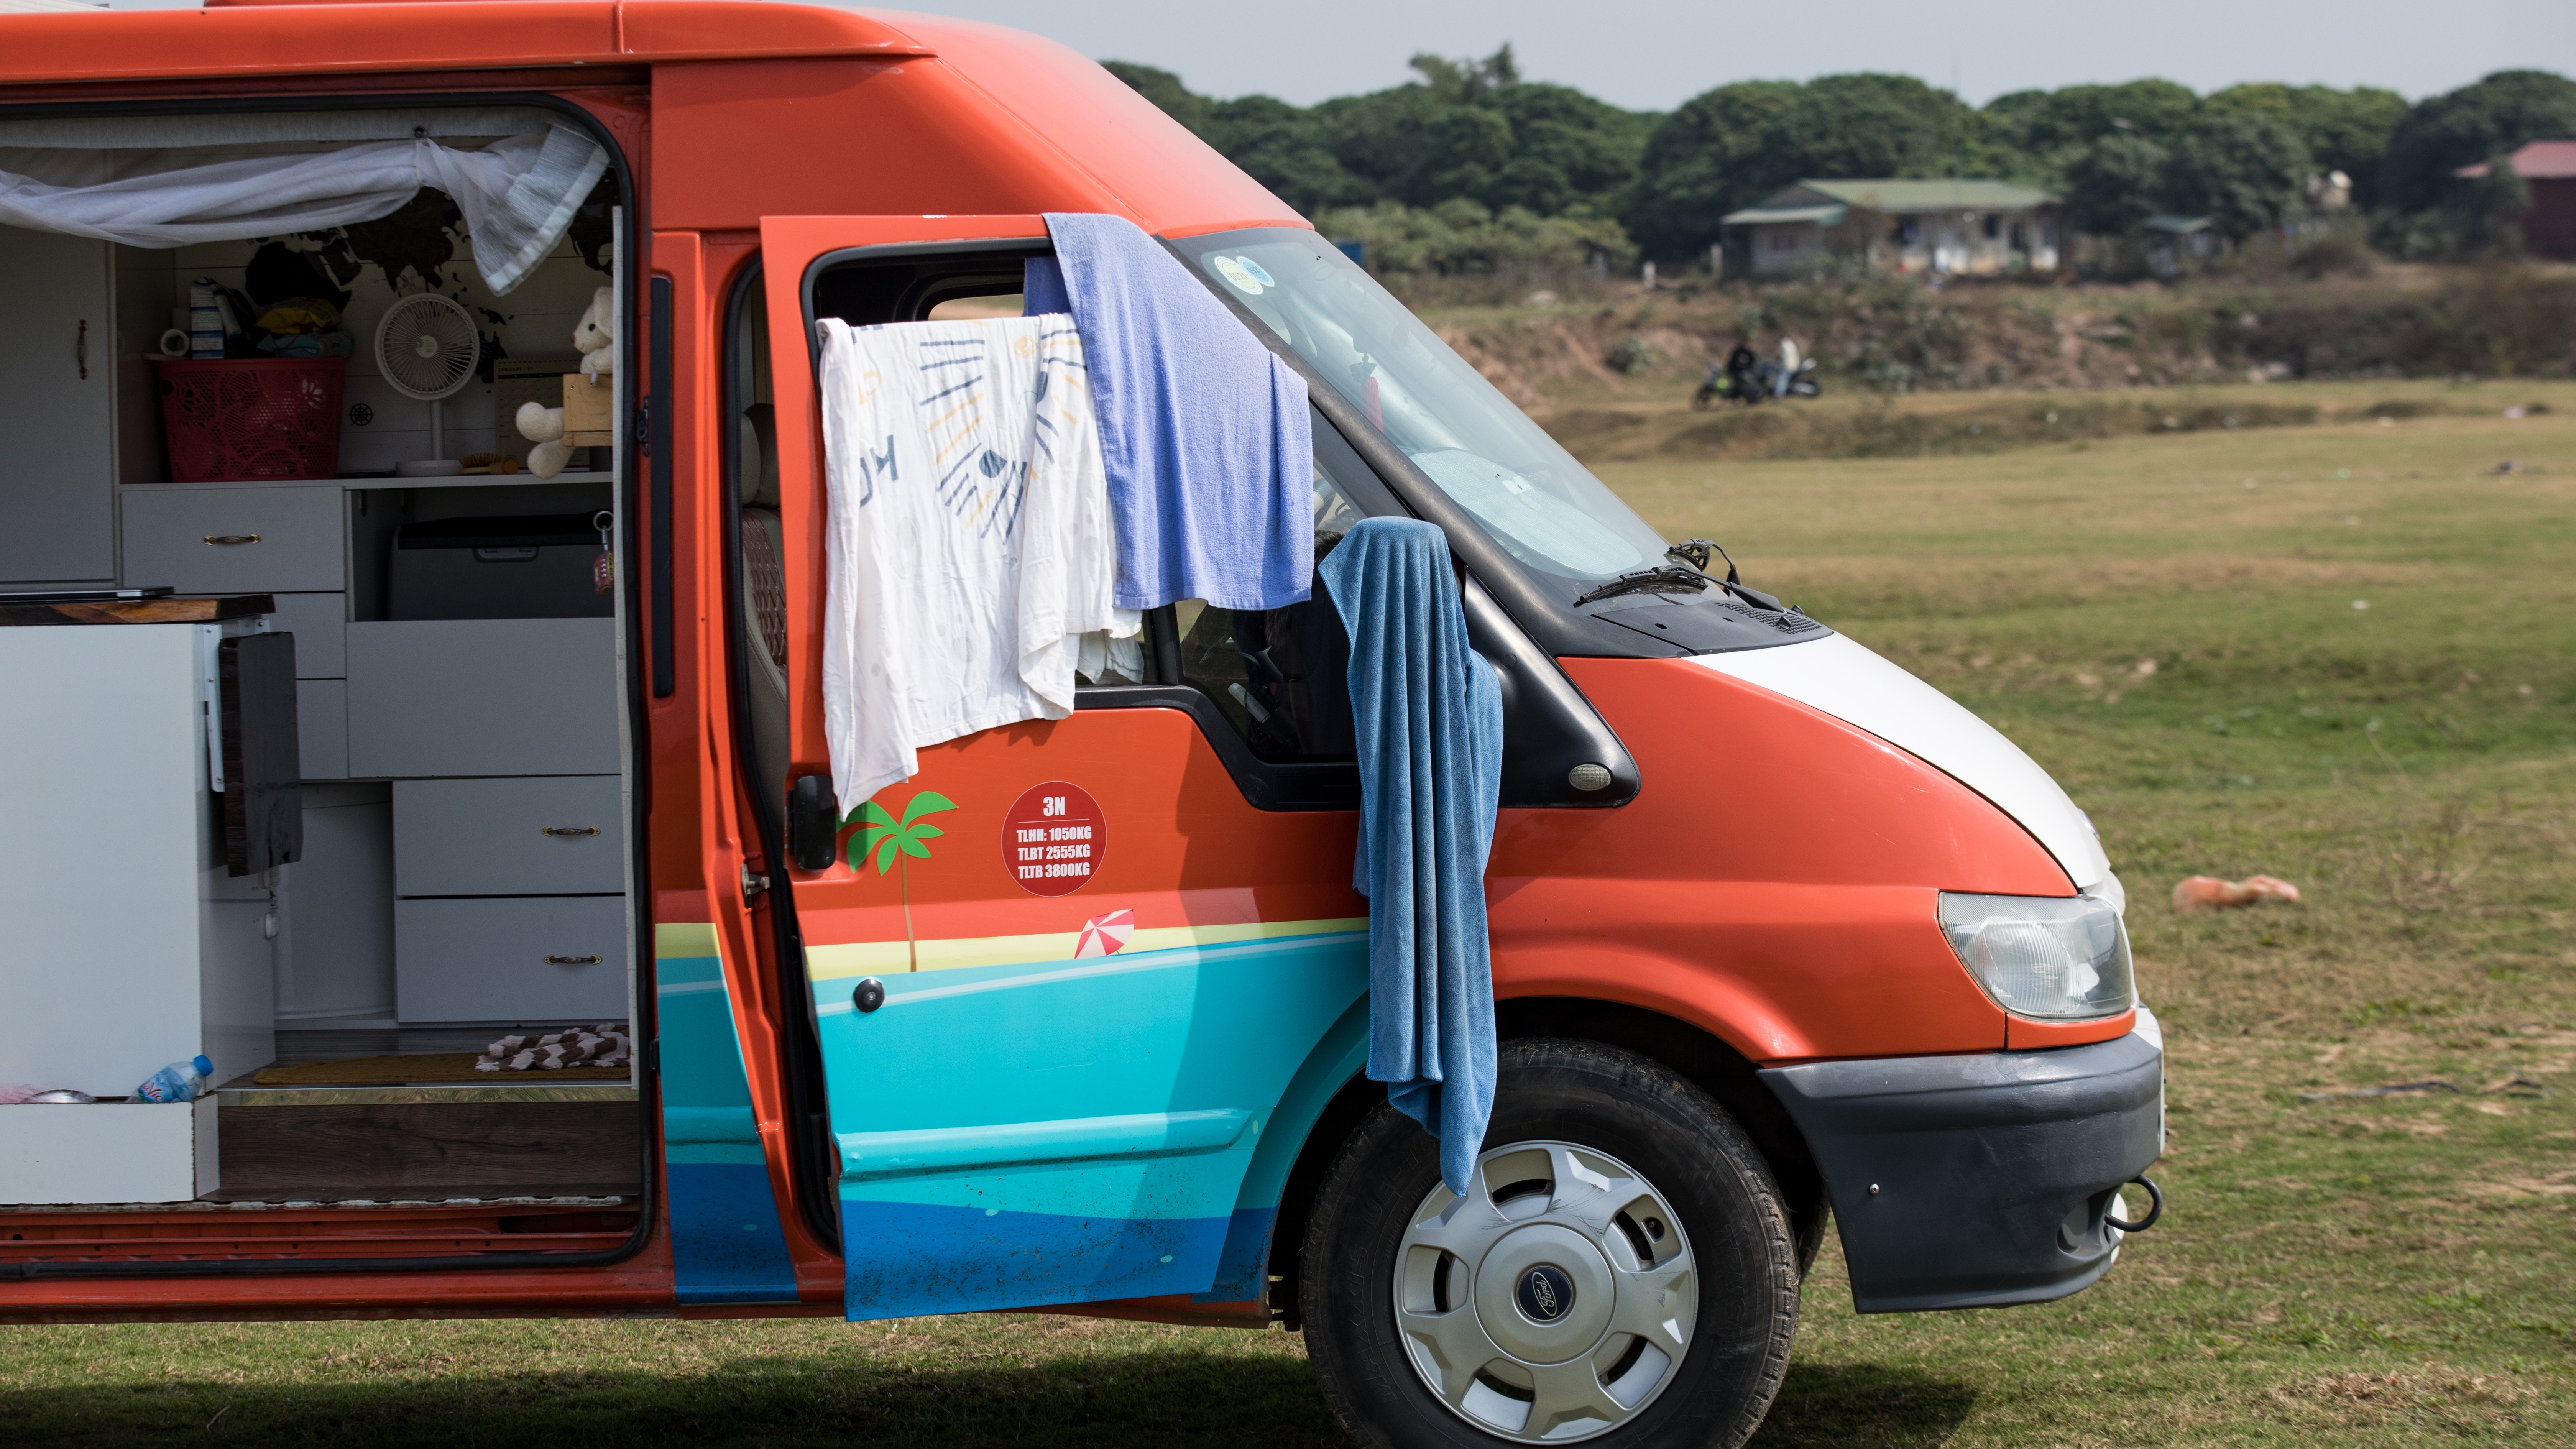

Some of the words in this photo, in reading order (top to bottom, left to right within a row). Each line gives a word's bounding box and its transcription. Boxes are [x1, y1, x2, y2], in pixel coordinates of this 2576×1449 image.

[1043, 796, 1066, 816] 3N
[1016, 828, 1047, 843] TLHH:
[1048, 826, 1092, 841] 1050KG
[1017, 846, 1045, 861] TLBT
[1046, 844, 1091, 859] 2555KG
[1018, 864, 1043, 879] TLTB
[1045, 862, 1090, 878] 3800KG
[1536, 1279, 1555, 1308] Ford
